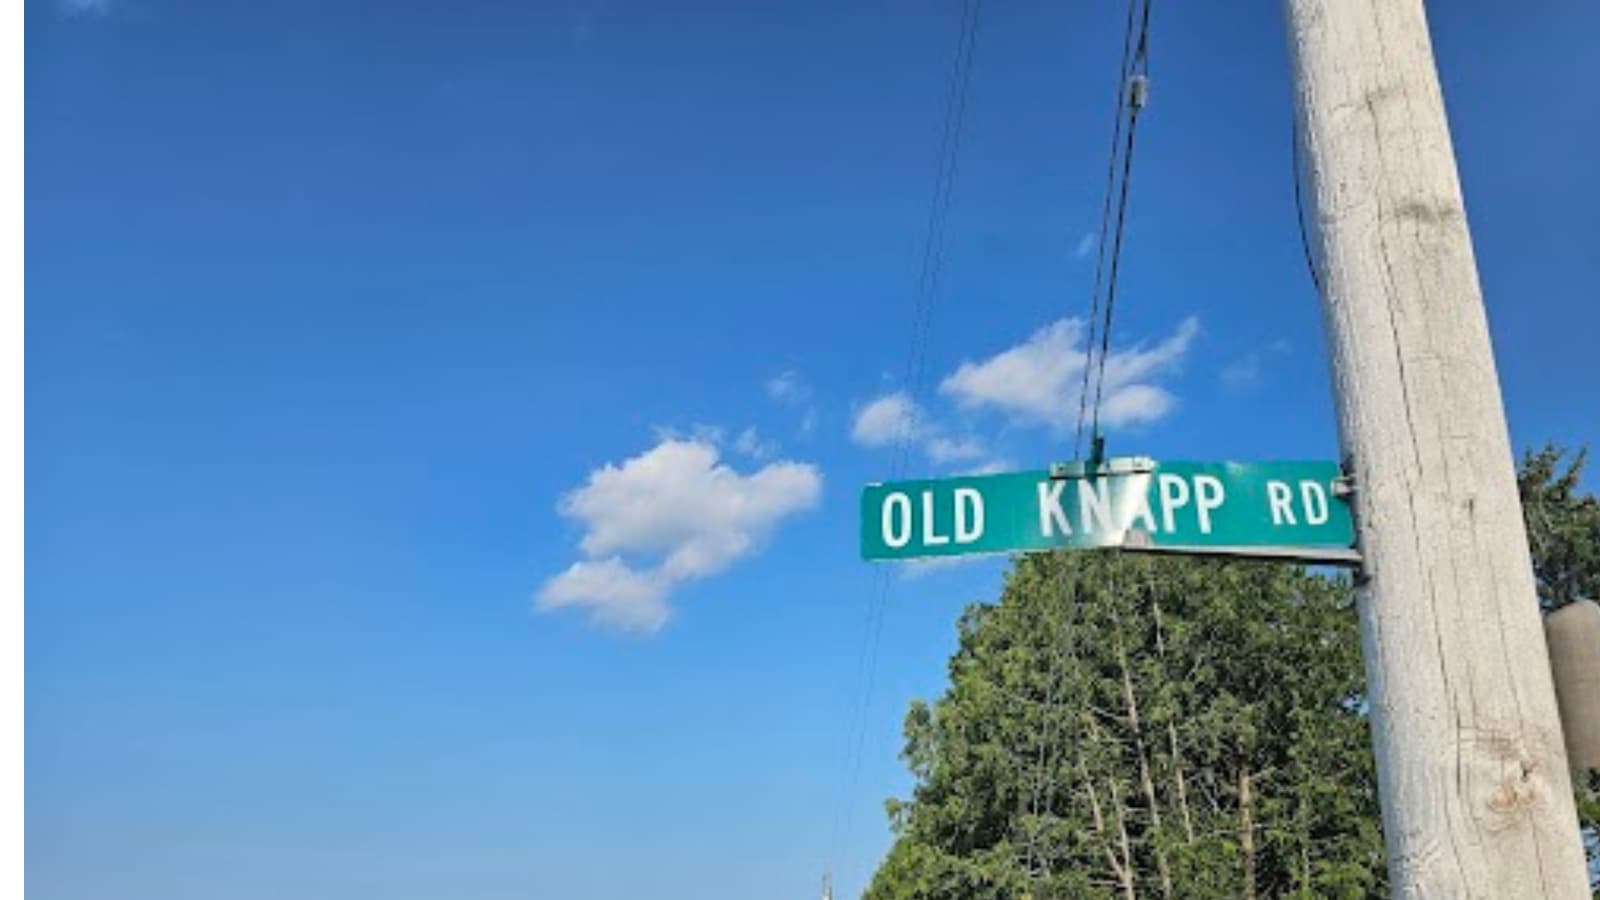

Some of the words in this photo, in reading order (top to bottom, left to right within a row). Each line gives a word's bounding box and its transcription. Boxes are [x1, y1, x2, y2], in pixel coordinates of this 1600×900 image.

[881, 488, 985, 548] OLD
[1037, 474, 1225, 537] KNAPP
[1267, 480, 1329, 526] RD
